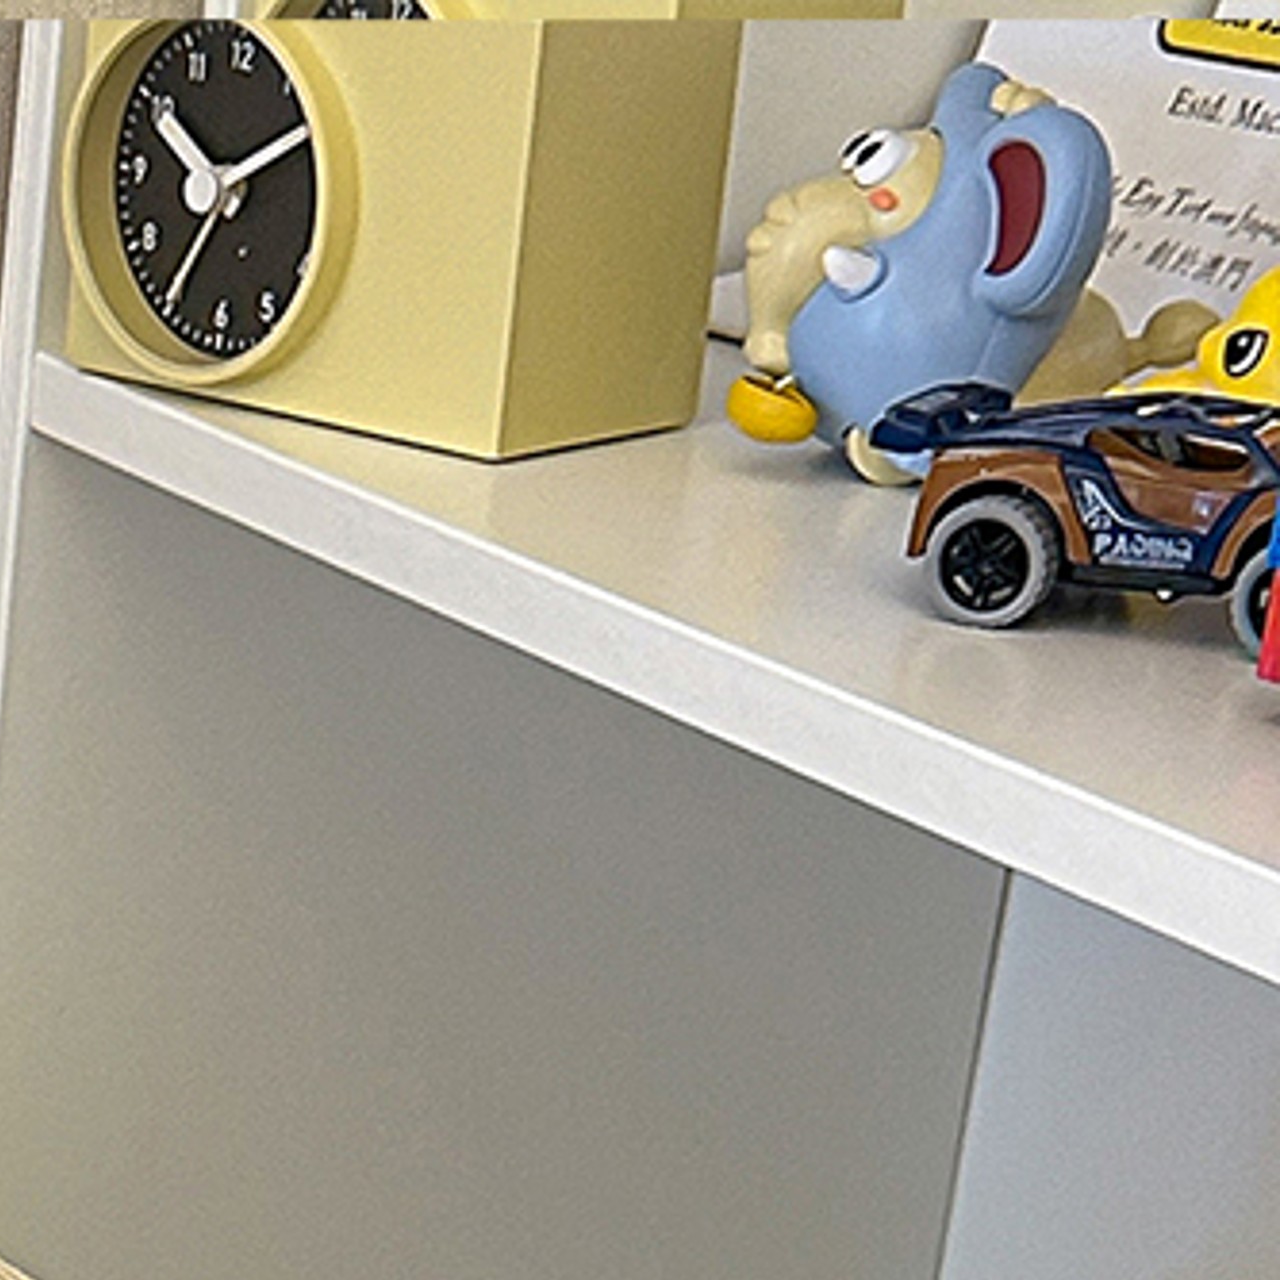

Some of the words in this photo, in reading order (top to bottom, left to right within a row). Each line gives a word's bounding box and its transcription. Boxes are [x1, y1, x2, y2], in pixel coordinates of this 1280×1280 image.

[187, 52, 207, 83] 11
[230, 40, 257, 74] 12
[132, 155, 148, 184] 9
[142, 221, 160, 251] 8
[213, 299, 230, 329] 6
[259, 290, 277, 323] 5
